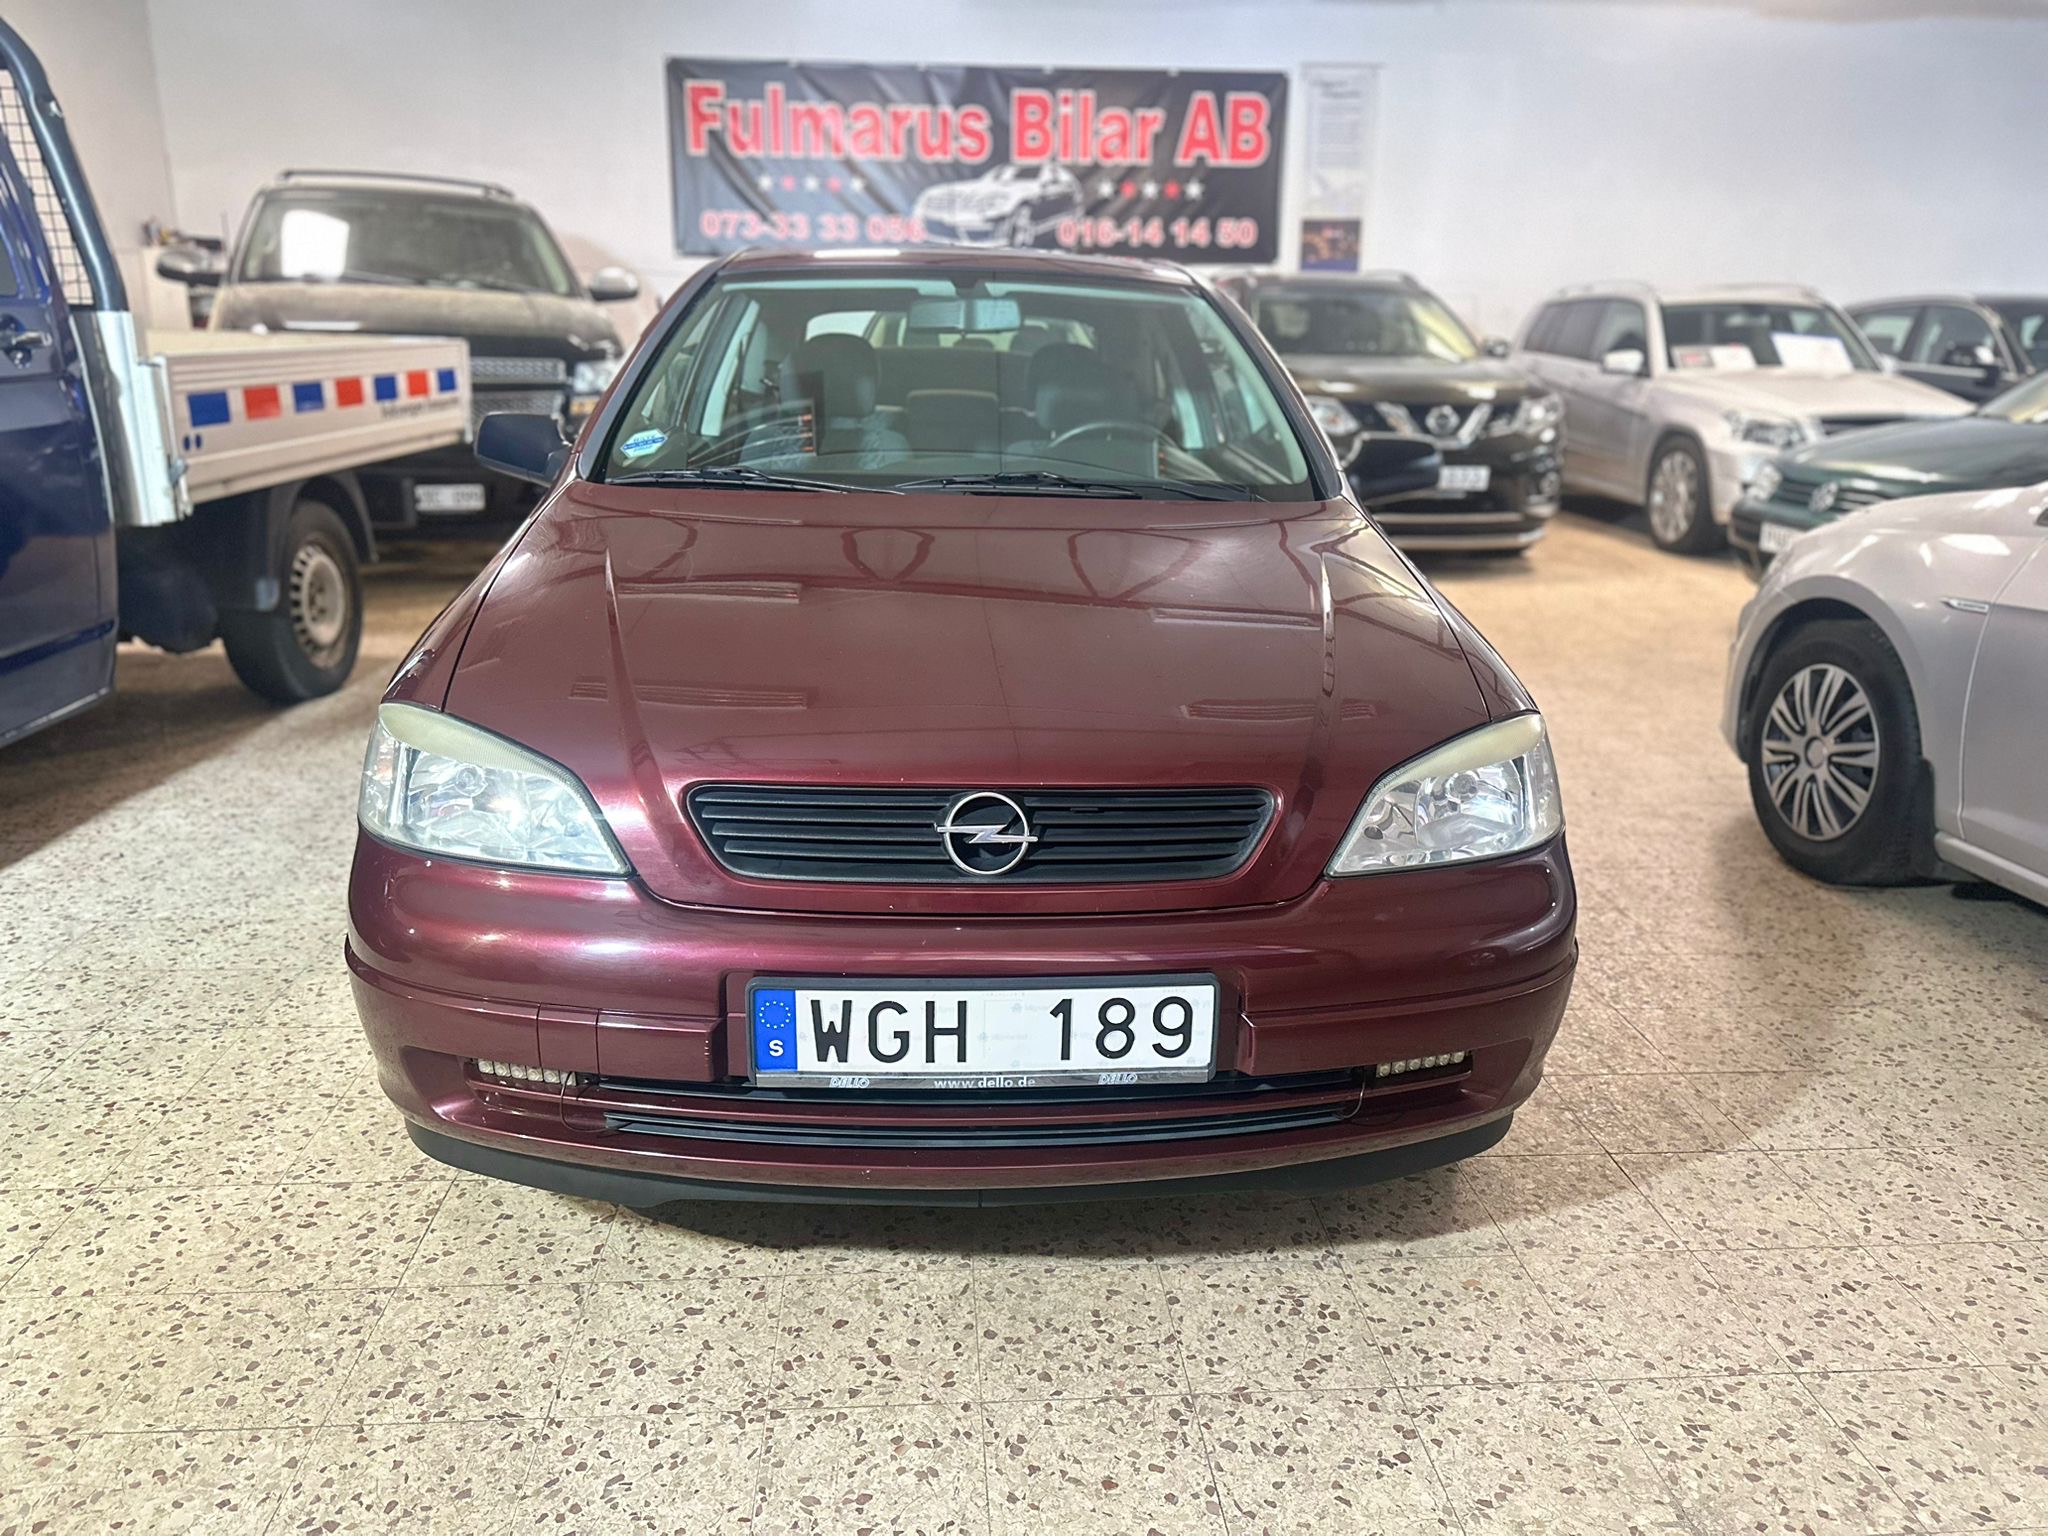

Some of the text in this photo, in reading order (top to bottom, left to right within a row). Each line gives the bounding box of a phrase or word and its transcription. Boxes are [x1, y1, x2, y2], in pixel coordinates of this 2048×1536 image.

[686, 79, 992, 164] Fulmarus
[1011, 88, 1166, 166] Bilar
[1174, 91, 1271, 167] AB
[1170, 216, 1211, 248] 14
[811, 996, 1193, 1063] WGH 189
[769, 1040, 784, 1057] S
[932, 1076, 1036, 1089] www.dello.de
